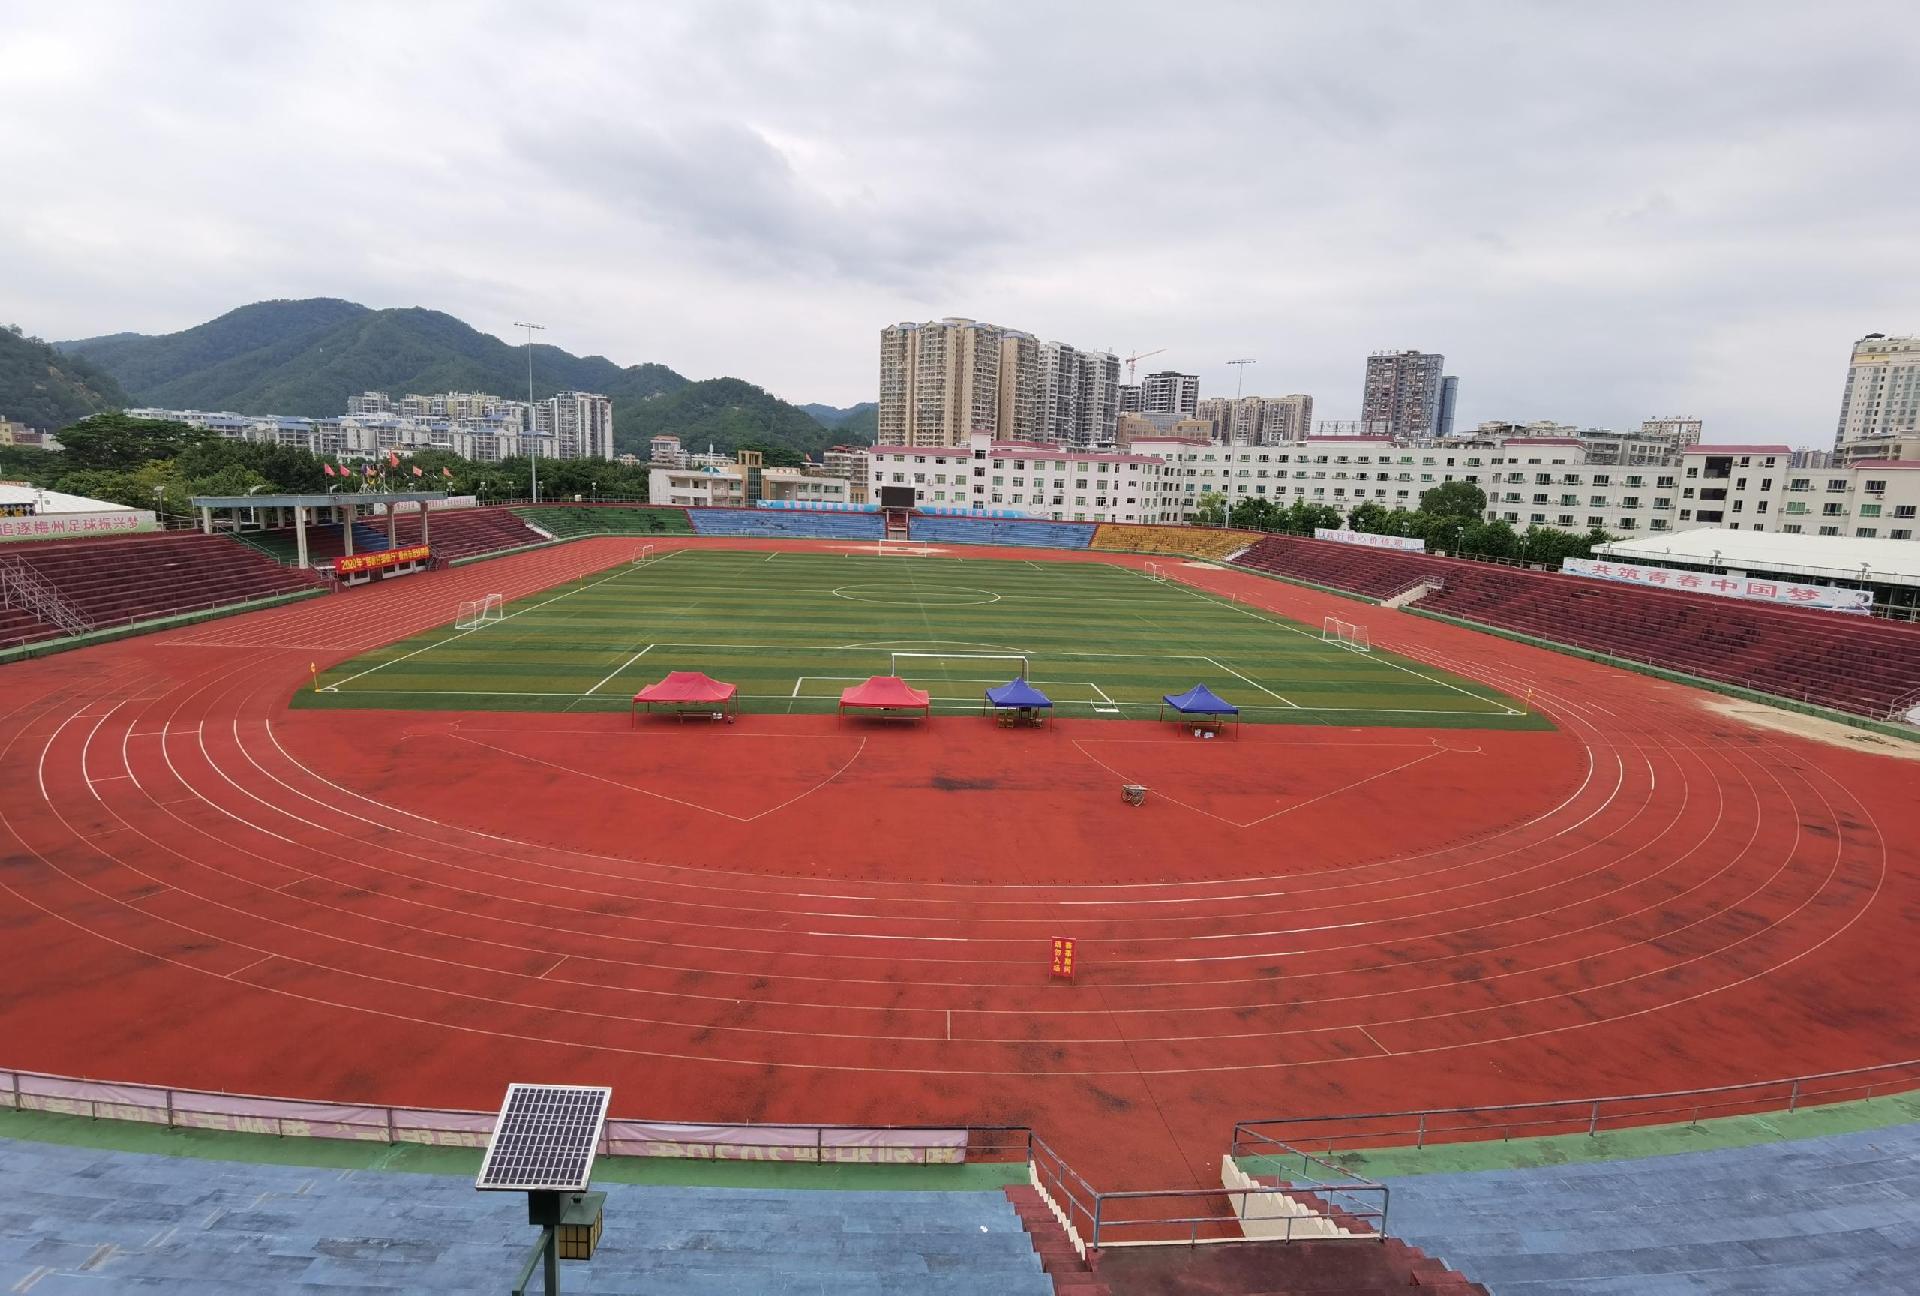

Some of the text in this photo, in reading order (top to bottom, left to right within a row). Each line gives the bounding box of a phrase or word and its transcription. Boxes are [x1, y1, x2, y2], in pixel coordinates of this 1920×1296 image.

[0, 516, 139, 537] 追逐梅州足球振兴梦
[1592, 564, 1820, 601] 共筑青春中国梦
